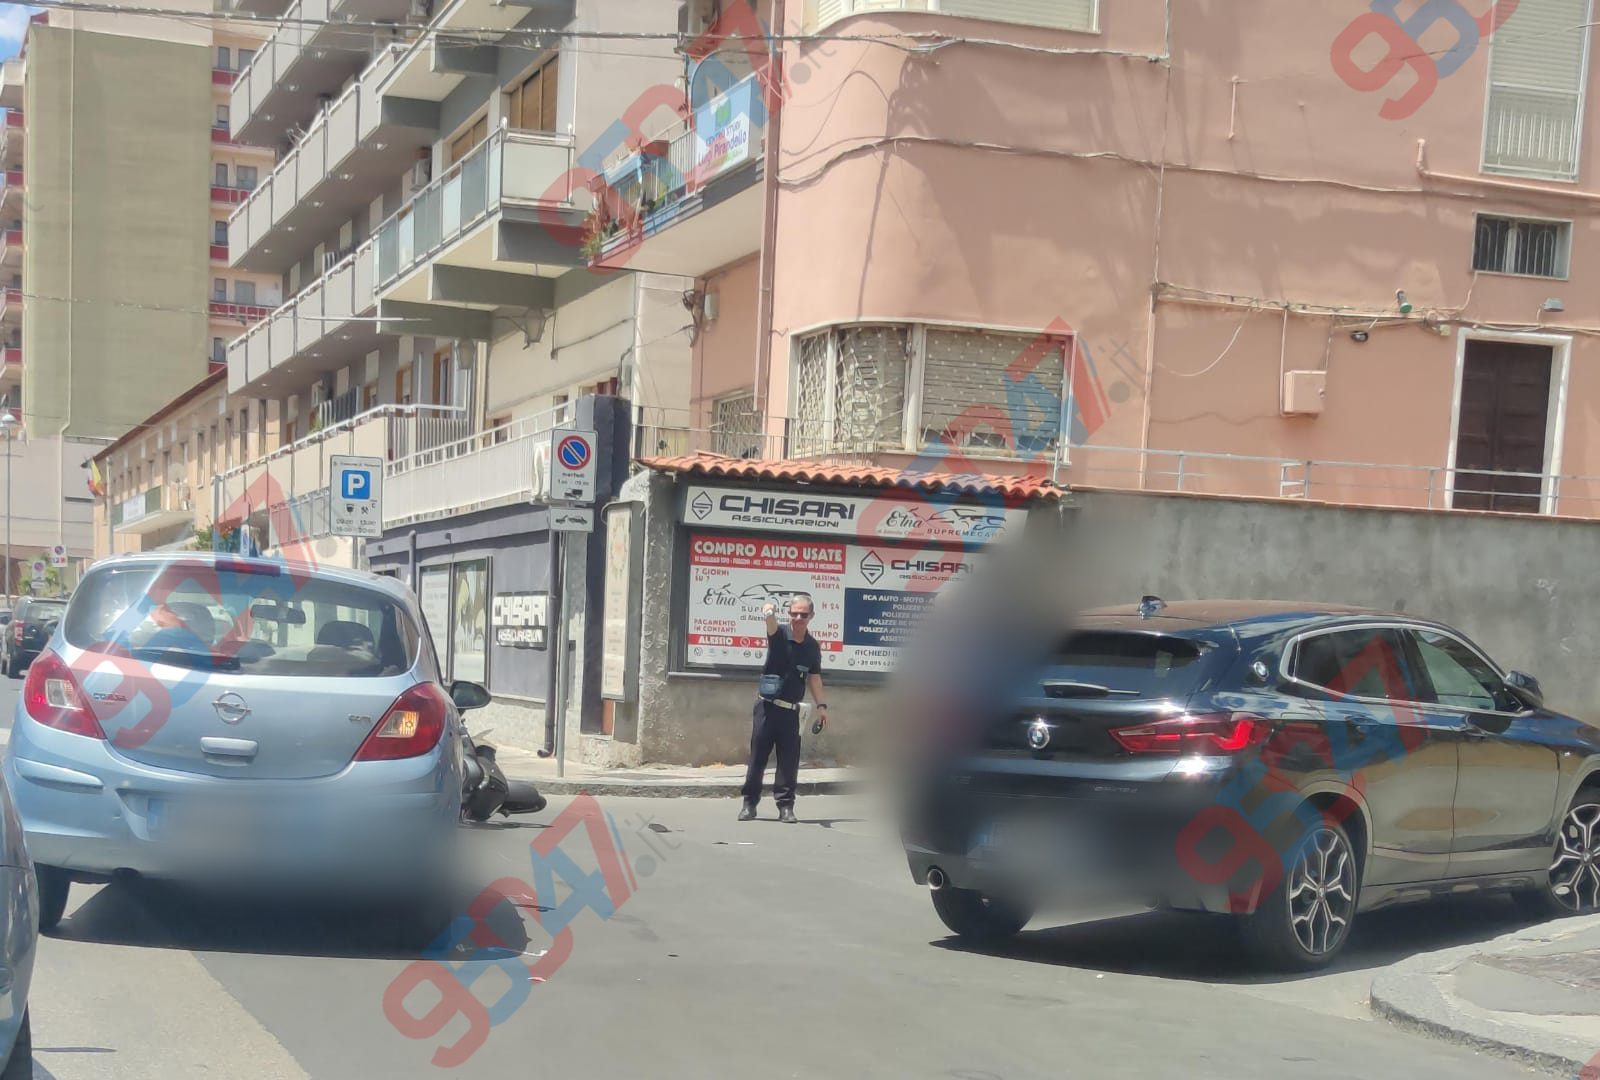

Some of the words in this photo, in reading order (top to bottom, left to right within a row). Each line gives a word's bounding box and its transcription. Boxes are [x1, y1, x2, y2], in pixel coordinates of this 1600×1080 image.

[347, 474, 365, 496] P
[719, 495, 856, 520] CHISARI
[731, 514, 839, 528] ASSICURAZIONI
[694, 541, 757, 557] COMPRO
[761, 544, 799, 560] AUTO
[803, 547, 843, 562] USATE
[702, 568, 730, 576] GIORNI
[810, 574, 841, 582] MASSIMA
[703, 588, 736, 606] Etna
[694, 618, 737, 627] PAGAMENTO
[859, 626, 889, 634] POLIZZA
[698, 635, 734, 646] ALESSIO
